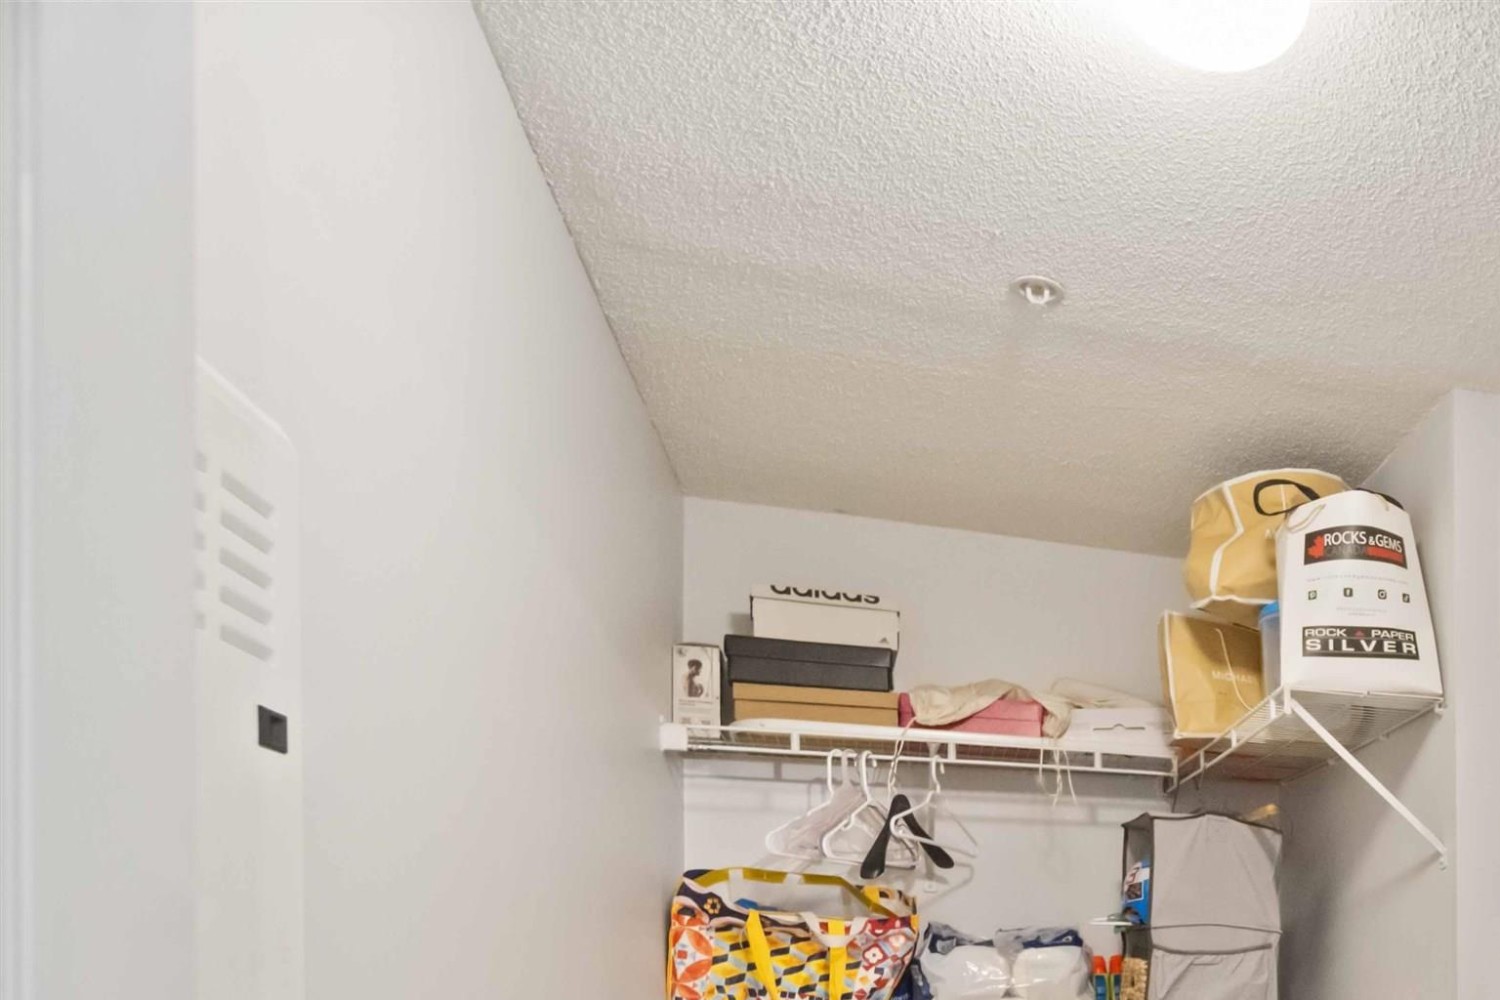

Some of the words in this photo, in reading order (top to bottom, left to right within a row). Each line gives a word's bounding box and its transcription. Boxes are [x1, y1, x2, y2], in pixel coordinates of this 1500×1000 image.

[1323, 530, 1367, 547] ROCKS
[1375, 534, 1403, 553] GEMS
[1304, 628, 1347, 637] ROCK
[1371, 629, 1414, 642] PAPER
[1305, 638, 1416, 655] SILVER
